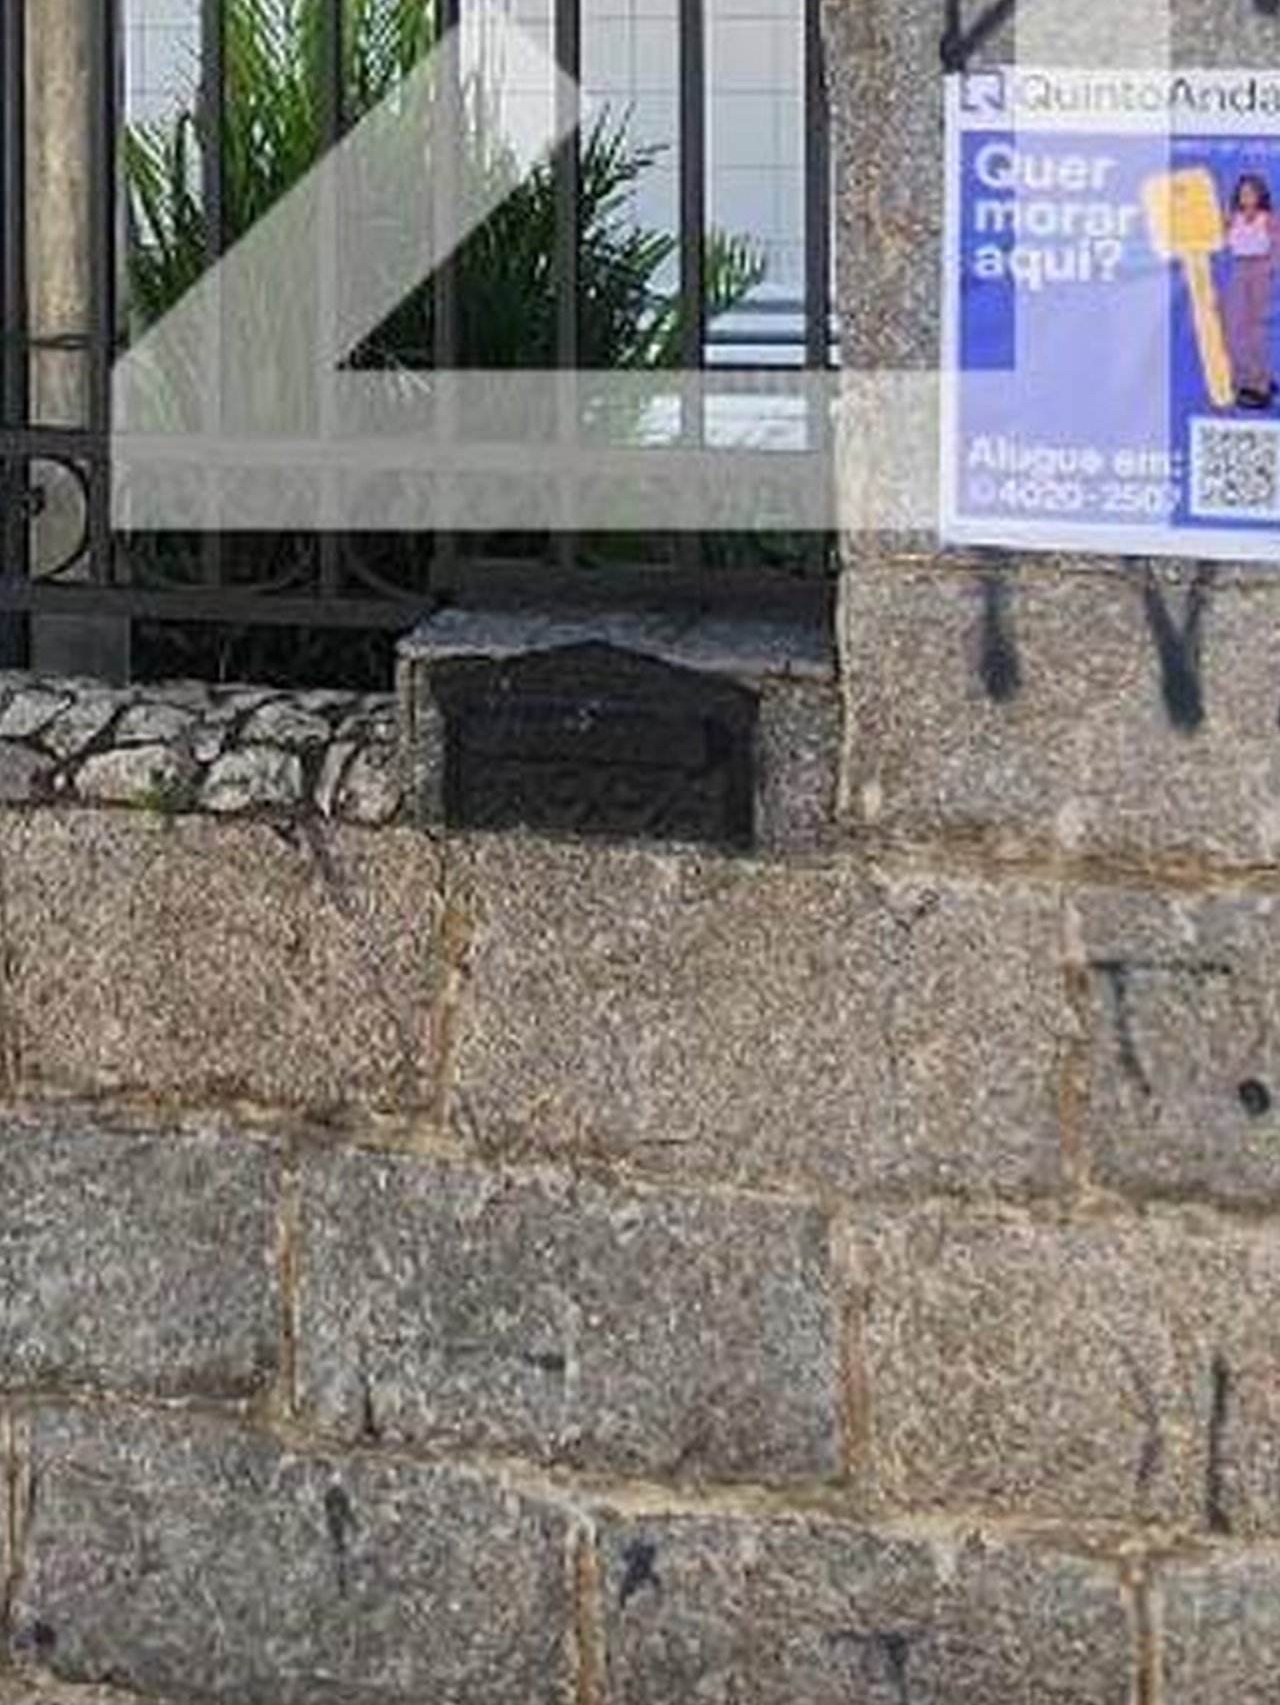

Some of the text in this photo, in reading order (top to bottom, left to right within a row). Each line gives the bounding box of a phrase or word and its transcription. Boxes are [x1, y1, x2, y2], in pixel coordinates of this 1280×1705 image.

[973, 142, 1118, 193] Quer
[973, 195, 1138, 237] morar
[973, 238, 1121, 290] aqui?
[969, 433, 1183, 480] Alugue em:
